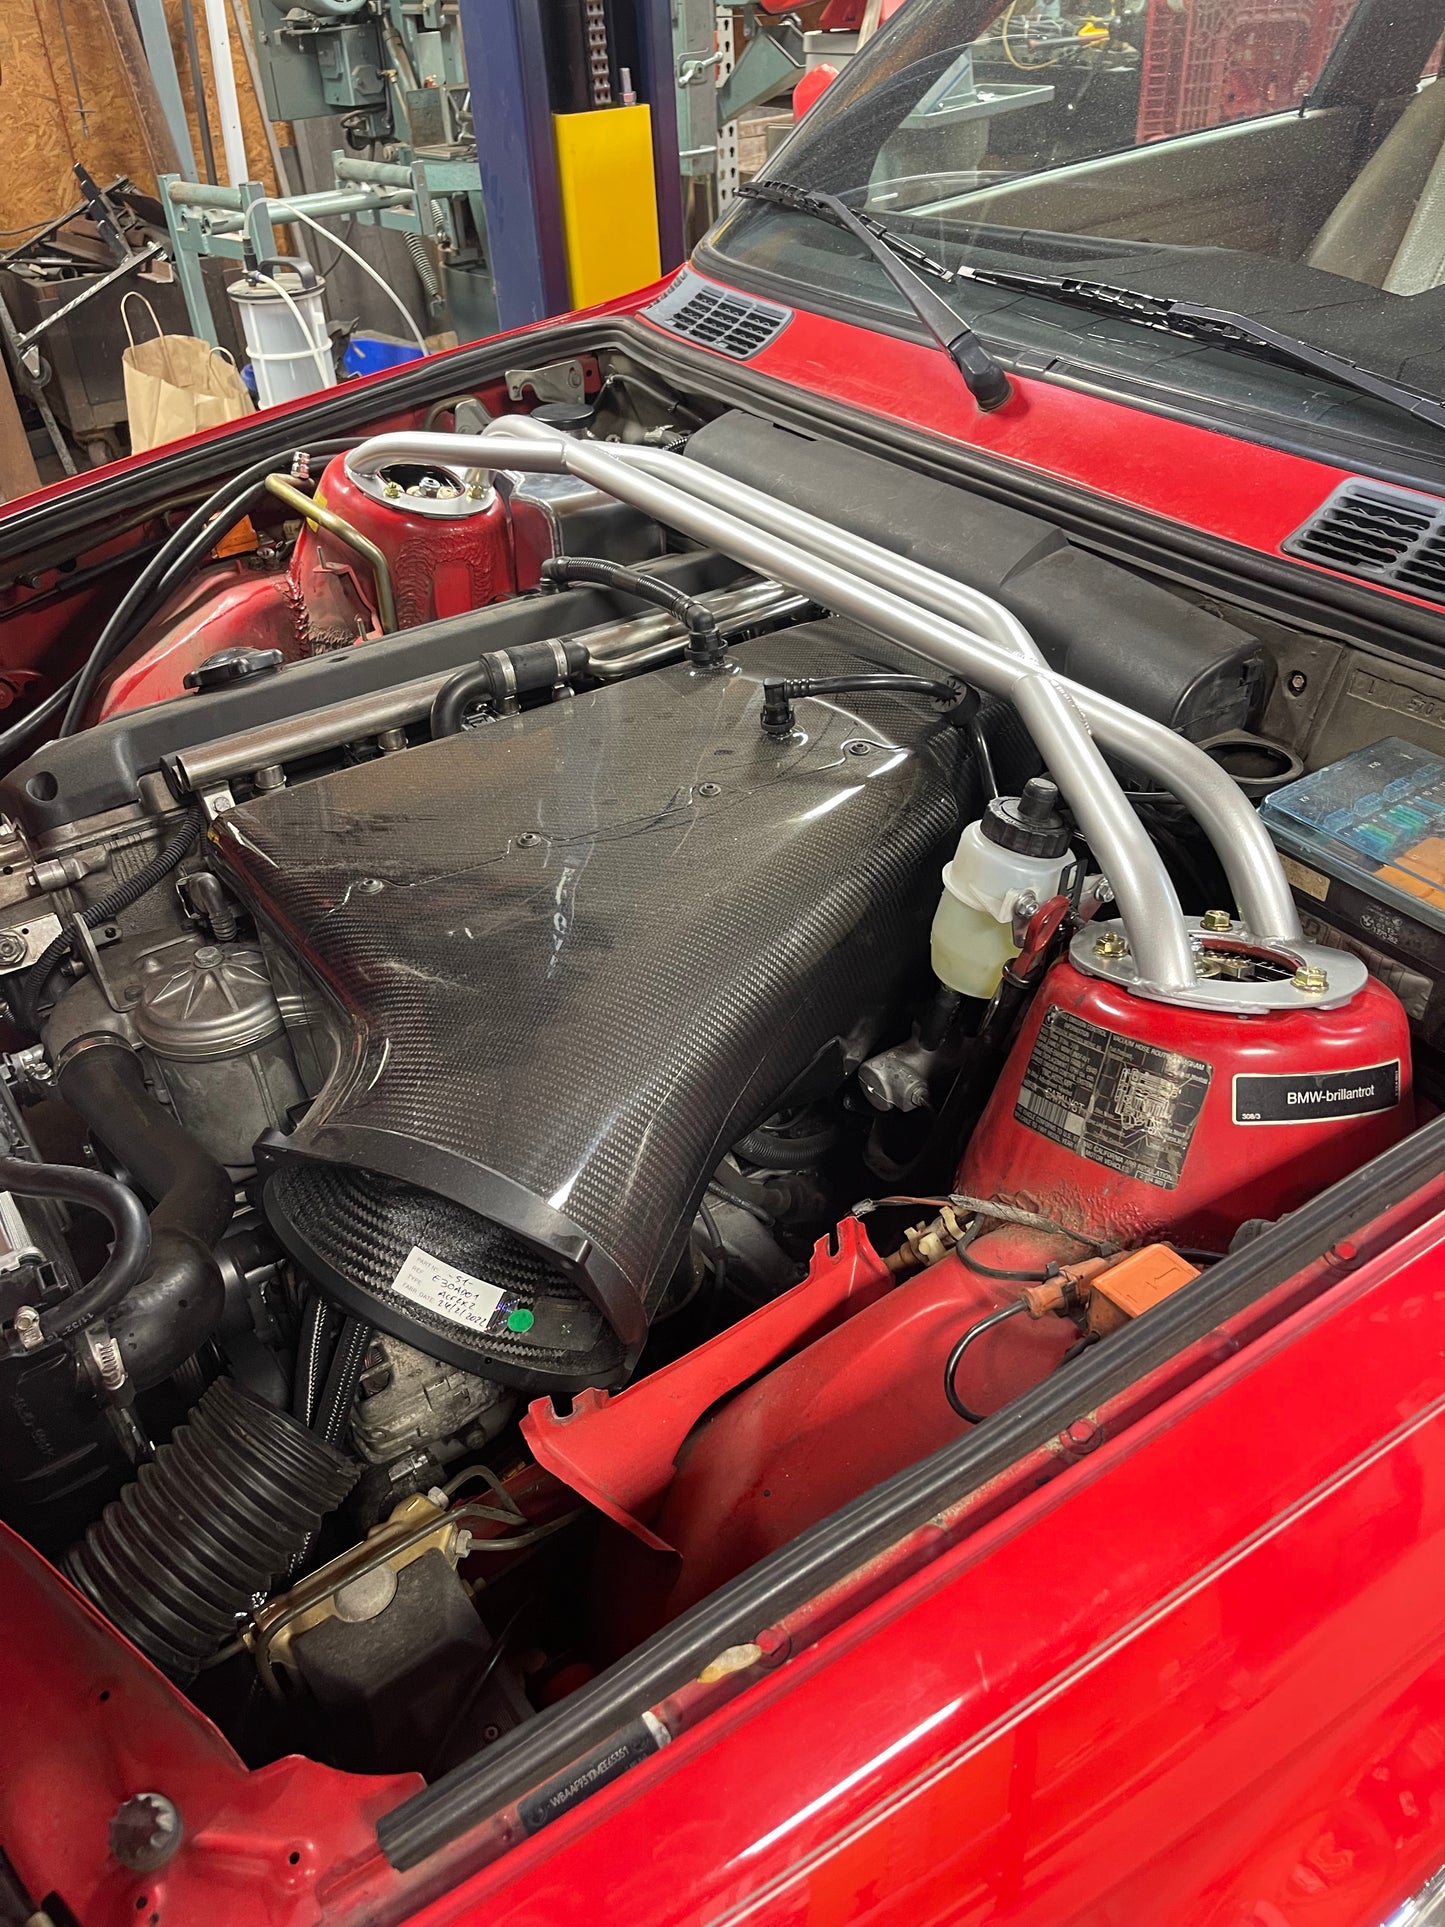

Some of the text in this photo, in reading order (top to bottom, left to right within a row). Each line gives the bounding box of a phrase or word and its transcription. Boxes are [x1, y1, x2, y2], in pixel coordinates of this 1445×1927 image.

[1113, 1034, 1135, 1047] VACUUM
[1135, 1041, 1151, 1054] HOSE
[1045, 1087, 1085, 1114] CATALYST
[1287, 1085, 1375, 1105] BMW-brillantrot
[1085, 1149, 1103, 1162] MOTOR
[1093, 1143, 1124, 1163] CALIFORNIA
